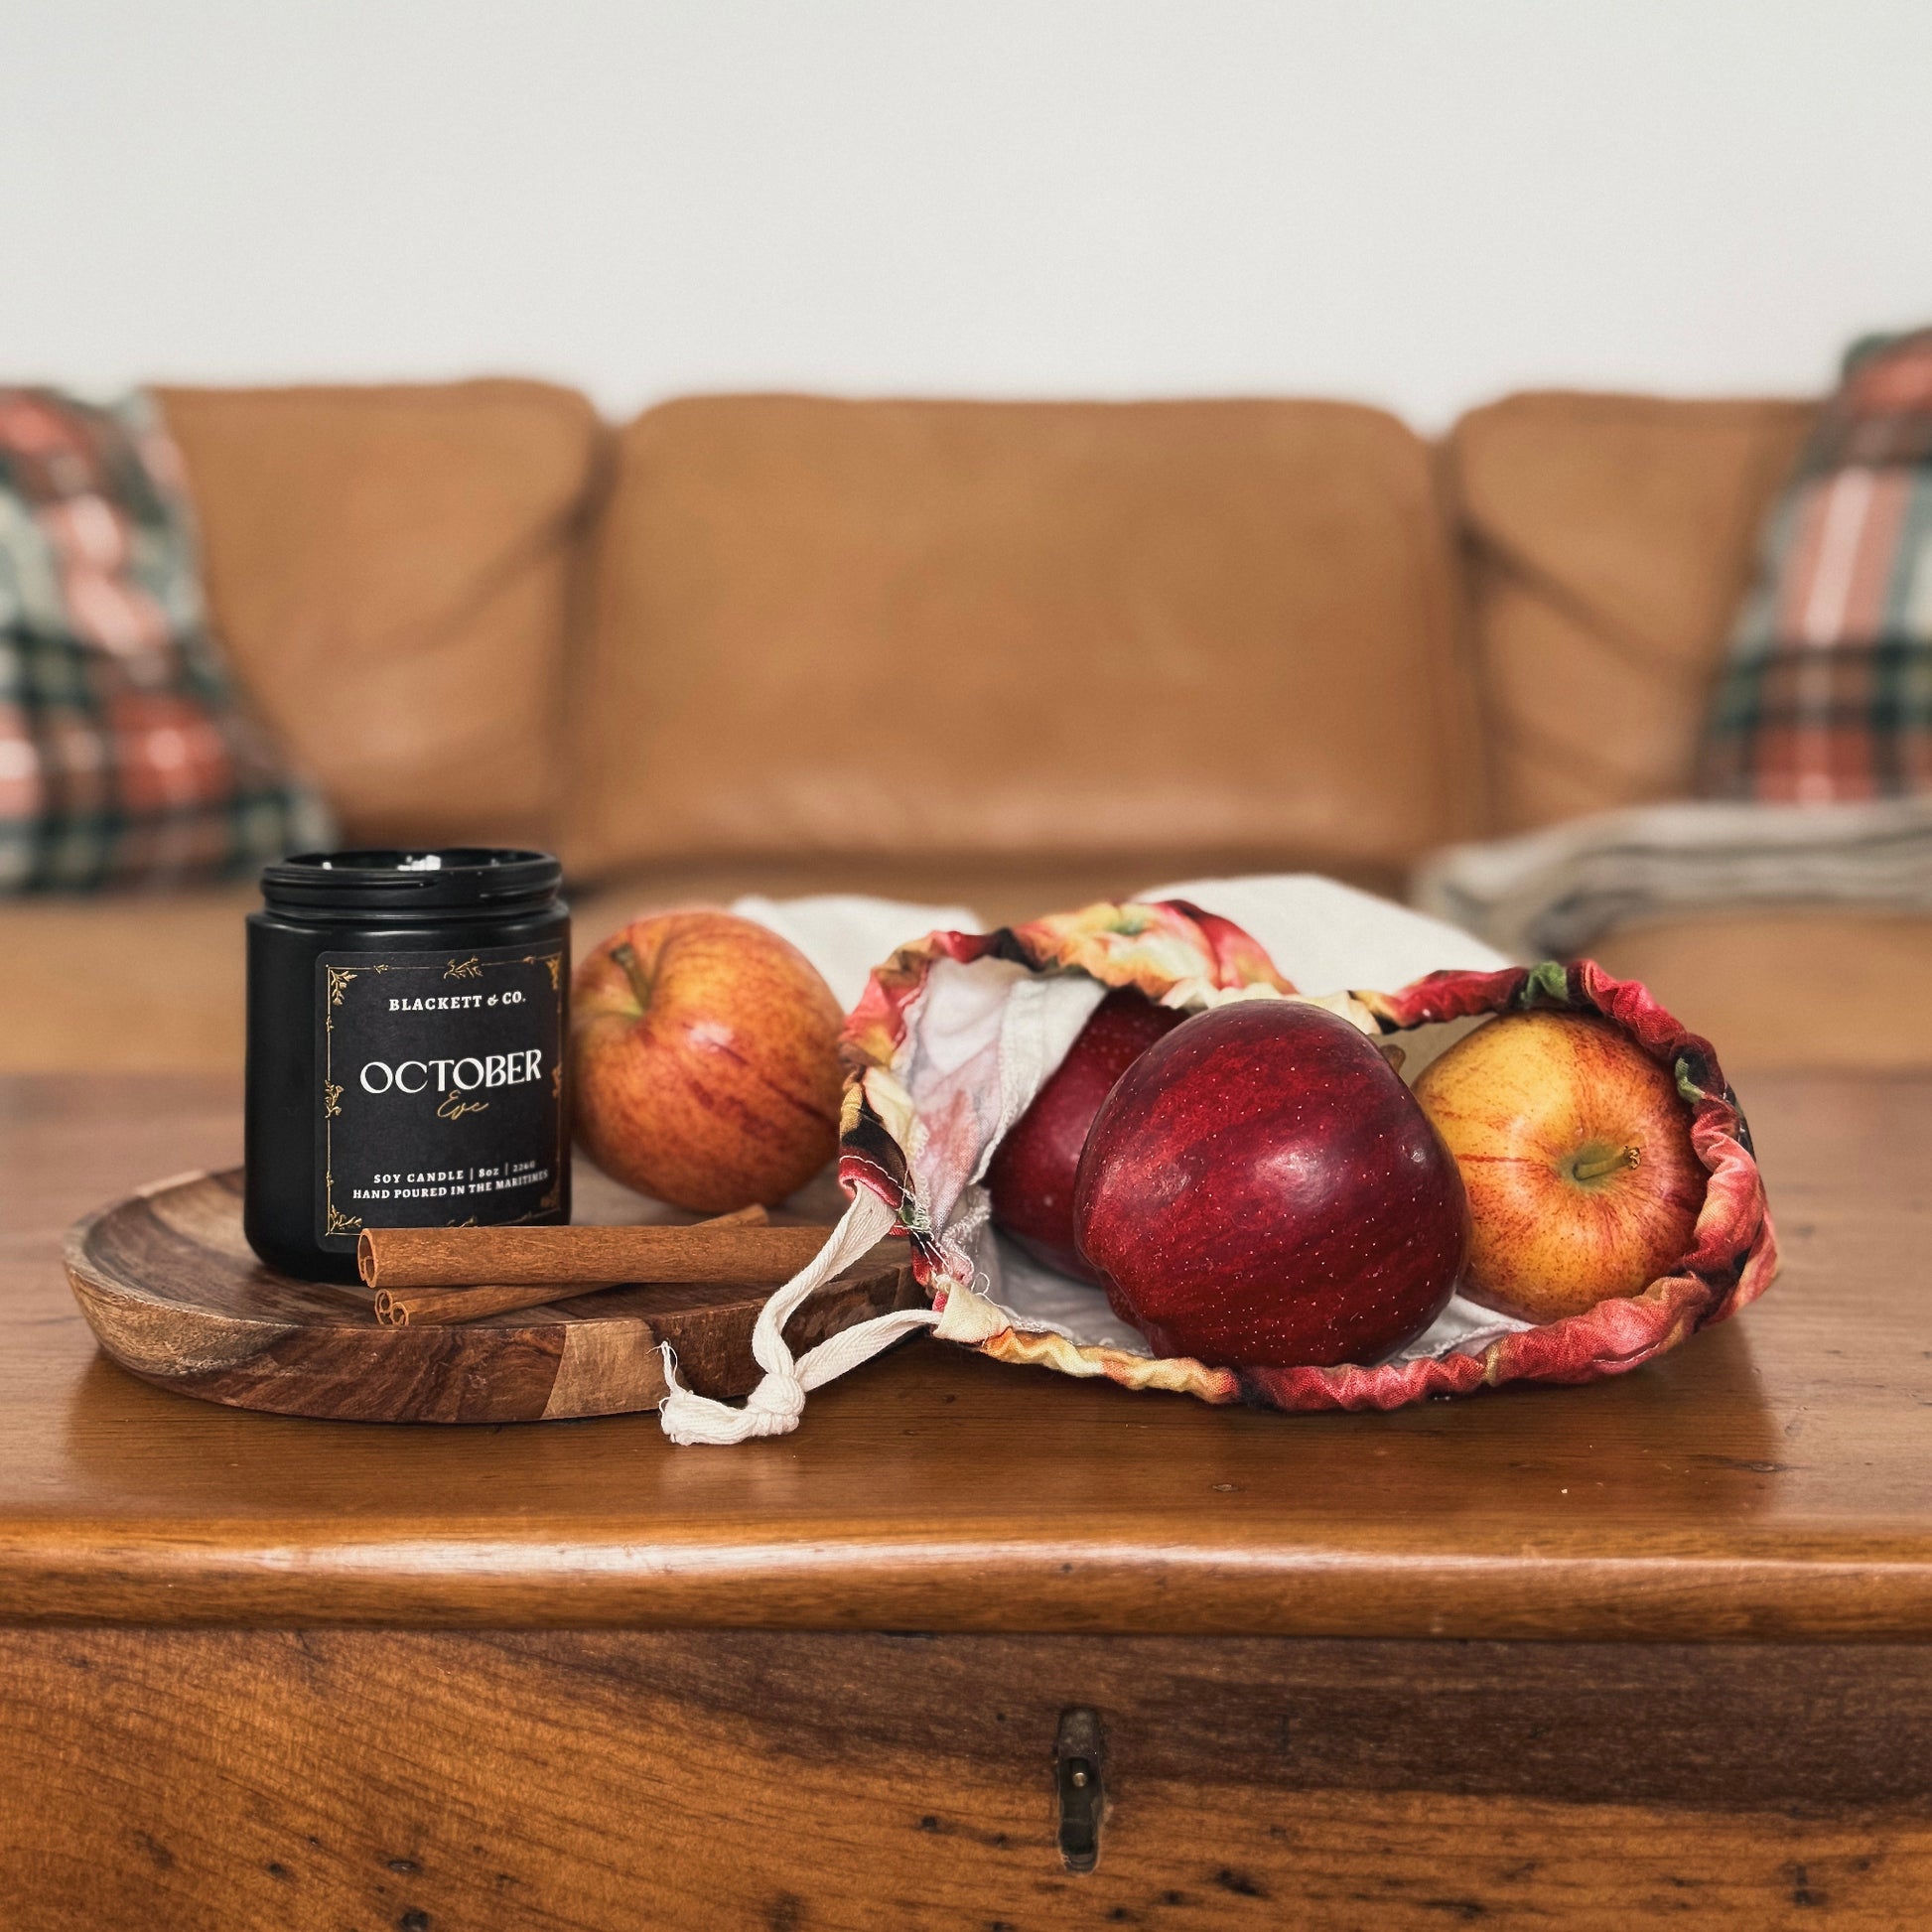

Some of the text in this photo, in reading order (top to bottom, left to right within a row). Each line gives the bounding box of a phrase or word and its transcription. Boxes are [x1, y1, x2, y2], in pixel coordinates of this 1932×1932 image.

[389, 991, 526, 1012] BLACKETT & CO.
[359, 1048, 542, 1094] OCTOBER
[352, 1169, 549, 1199] HAND POURED IN THE MARITIMES
[373, 1173, 401, 1184] SOY
[407, 1170, 465, 1183] CANDLE
